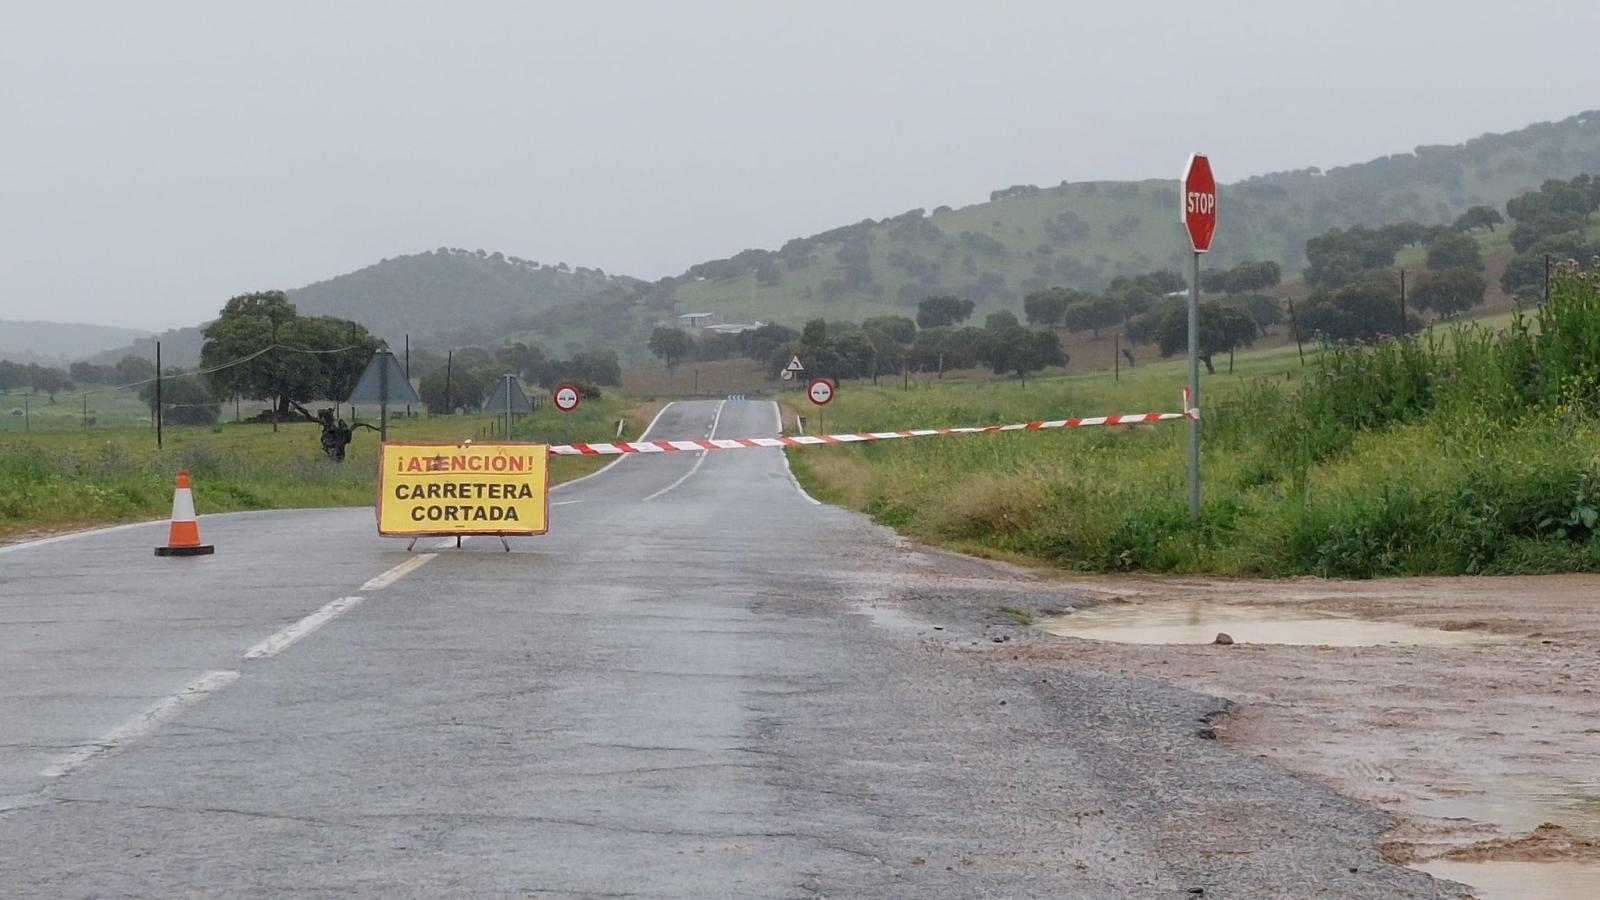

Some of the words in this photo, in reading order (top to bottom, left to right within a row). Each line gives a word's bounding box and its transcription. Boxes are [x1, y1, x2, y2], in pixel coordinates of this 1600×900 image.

[1187, 191, 1214, 214] STOP
[395, 482, 533, 500] CARRETERA
[411, 505, 519, 521] CORTADA
